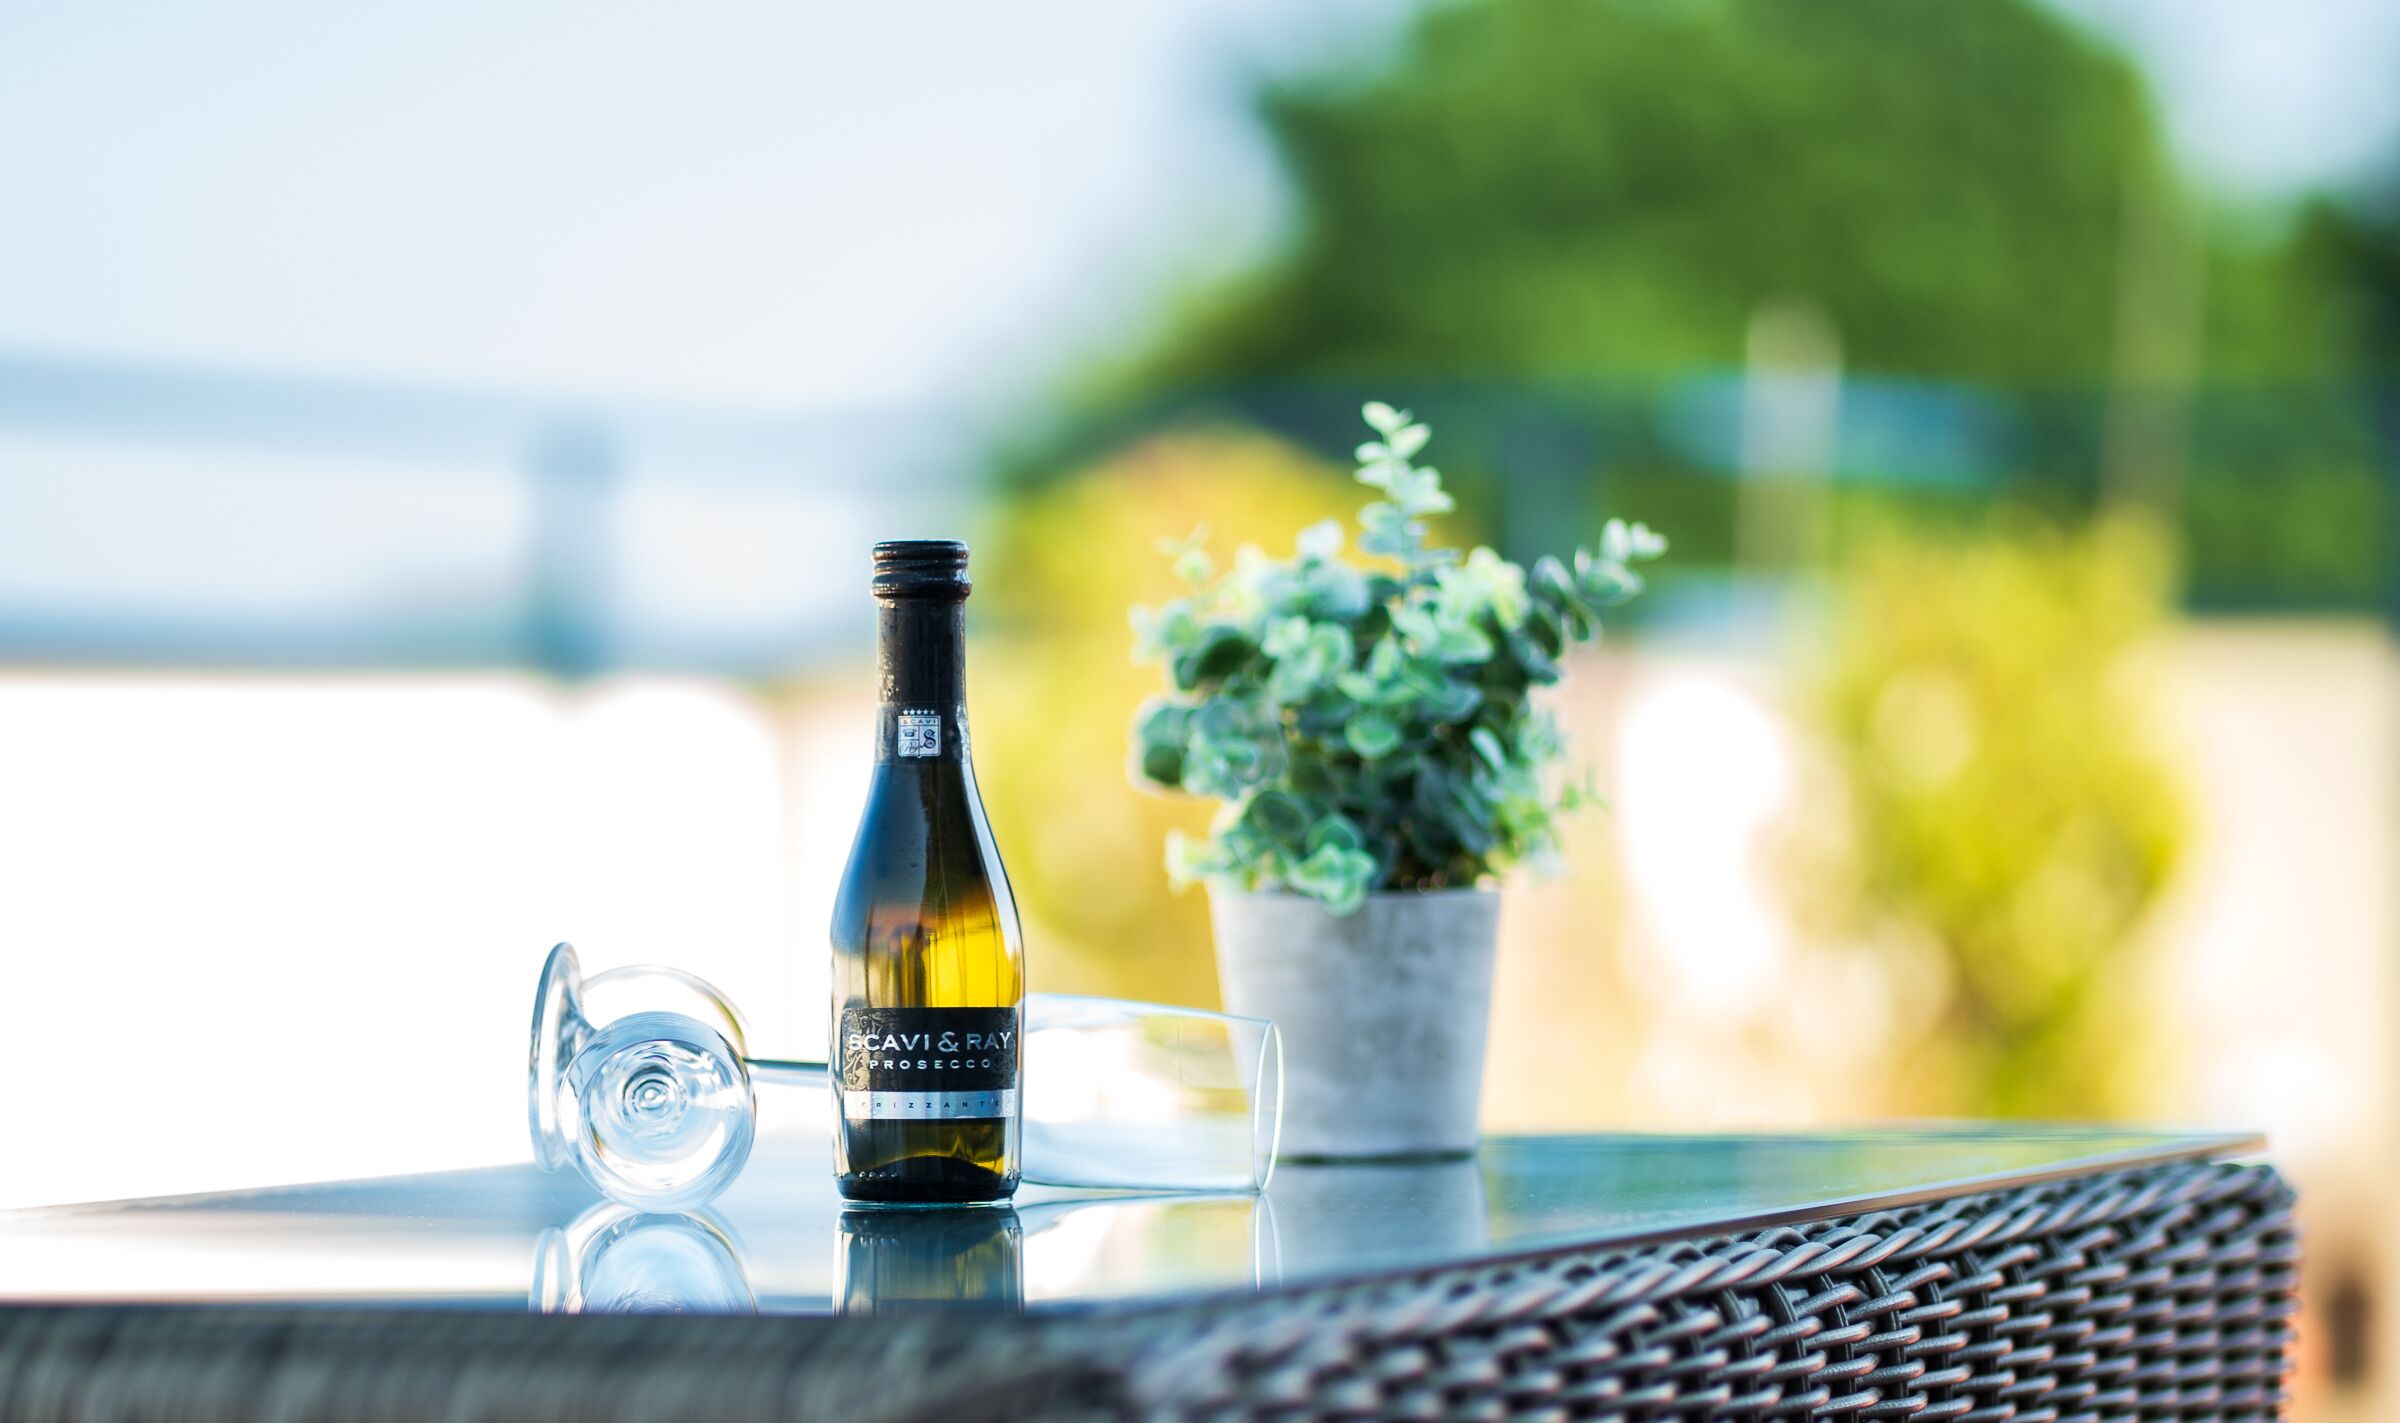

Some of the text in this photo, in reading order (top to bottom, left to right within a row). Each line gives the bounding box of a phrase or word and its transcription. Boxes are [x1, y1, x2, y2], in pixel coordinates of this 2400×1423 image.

[849, 1031, 1012, 1053] SCAVI & RAY
[869, 1058, 991, 1070] PROSECCO
